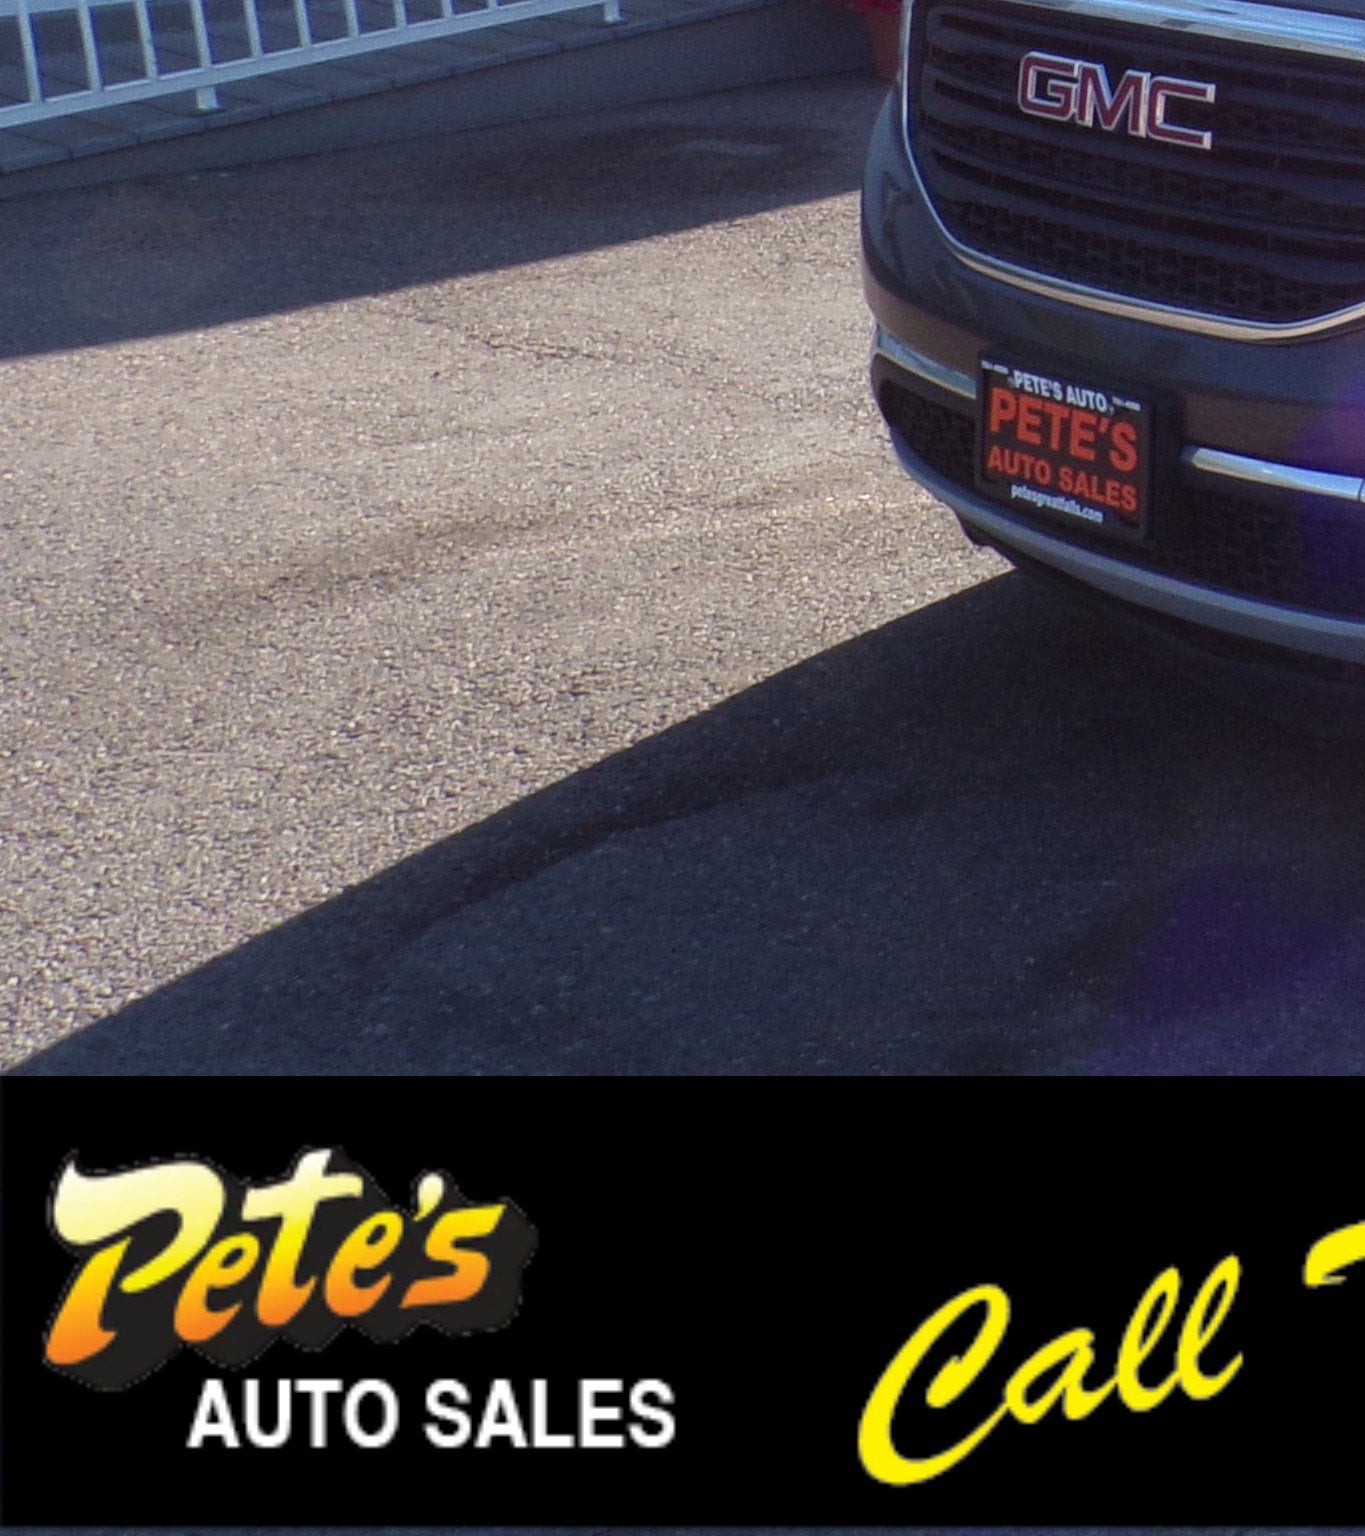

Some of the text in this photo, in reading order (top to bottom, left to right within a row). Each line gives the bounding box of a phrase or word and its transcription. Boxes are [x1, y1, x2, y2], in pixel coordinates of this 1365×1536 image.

[1017, 50, 1216, 150] GMC
[1012, 368, 1064, 401] PETE'S
[1065, 384, 1109, 413] AUTO
[988, 386, 1139, 473] PETE'S
[986, 445, 1139, 513] AUTO SALES
